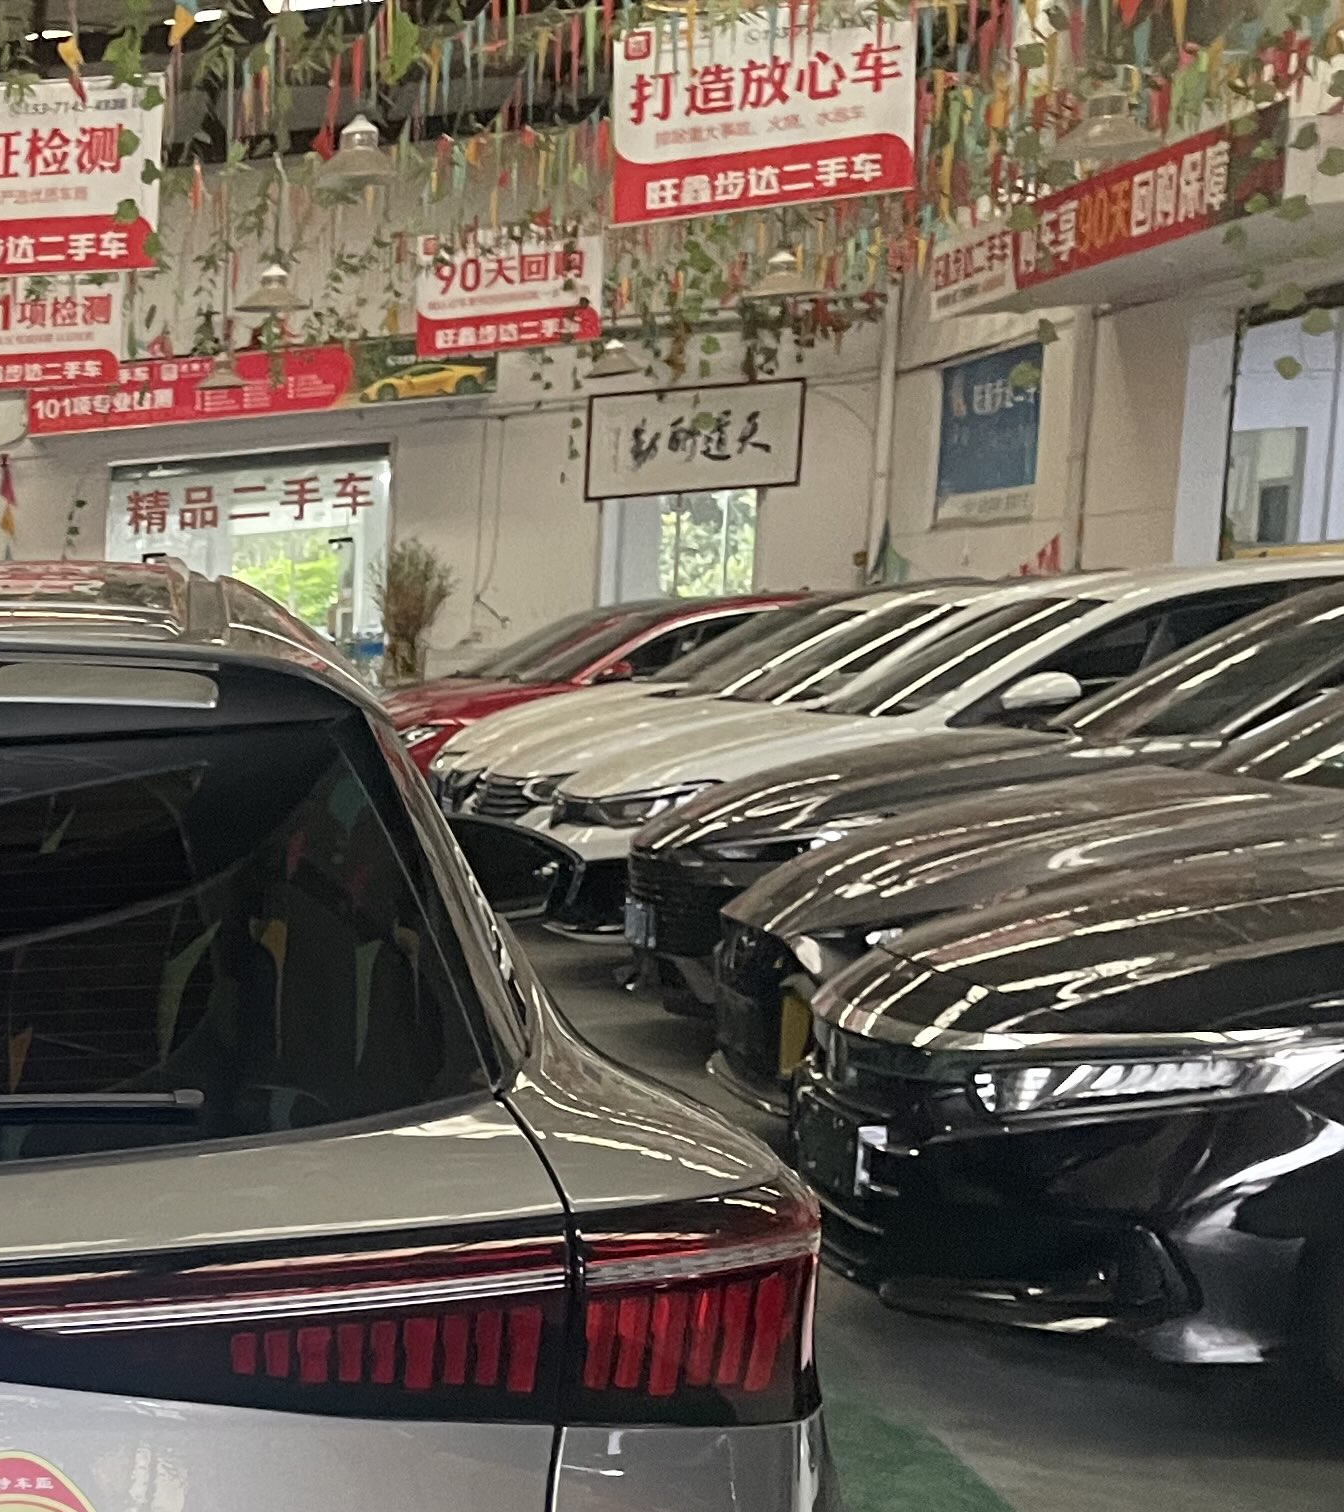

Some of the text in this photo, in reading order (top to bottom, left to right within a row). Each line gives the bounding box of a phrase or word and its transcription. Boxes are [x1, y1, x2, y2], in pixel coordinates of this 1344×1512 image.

[629, 42, 903, 126] 打造放心车
[645, 153, 883, 210] 旺鑫步达二手车
[126, 472, 374, 535] 精品二手车
